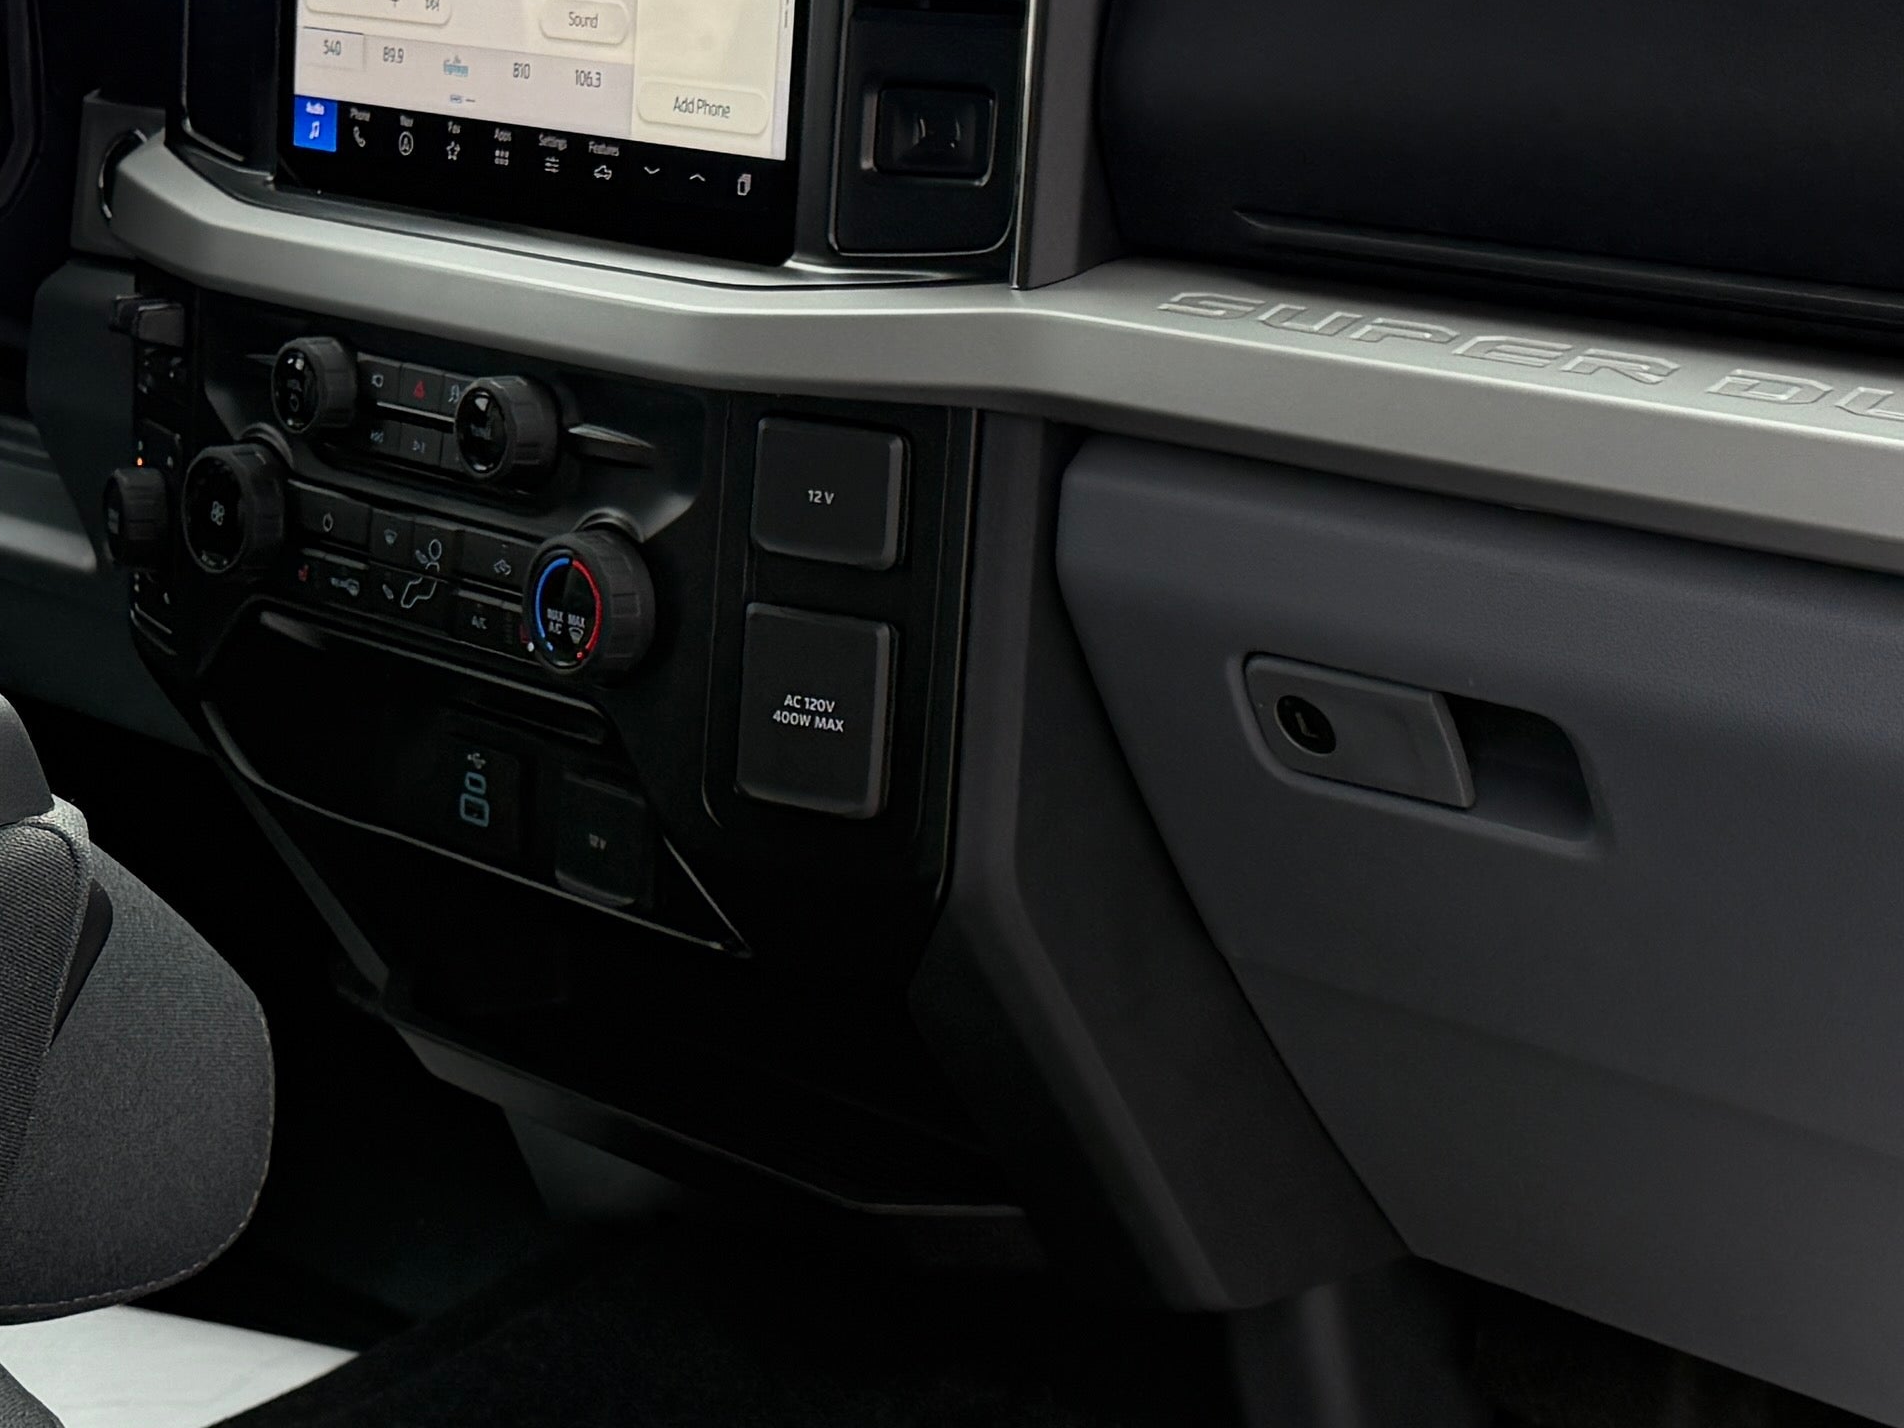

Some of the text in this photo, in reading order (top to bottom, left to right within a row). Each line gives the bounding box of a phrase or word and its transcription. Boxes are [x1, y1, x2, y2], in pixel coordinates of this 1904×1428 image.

[567, 11, 599, 29] Sound
[322, 39, 342, 57] 540
[672, 95, 732, 120] Add Phone
[1155, 289, 1682, 387] SUPER
[783, 693, 836, 714] AC 120V
[772, 709, 845, 733] 400W MAX
